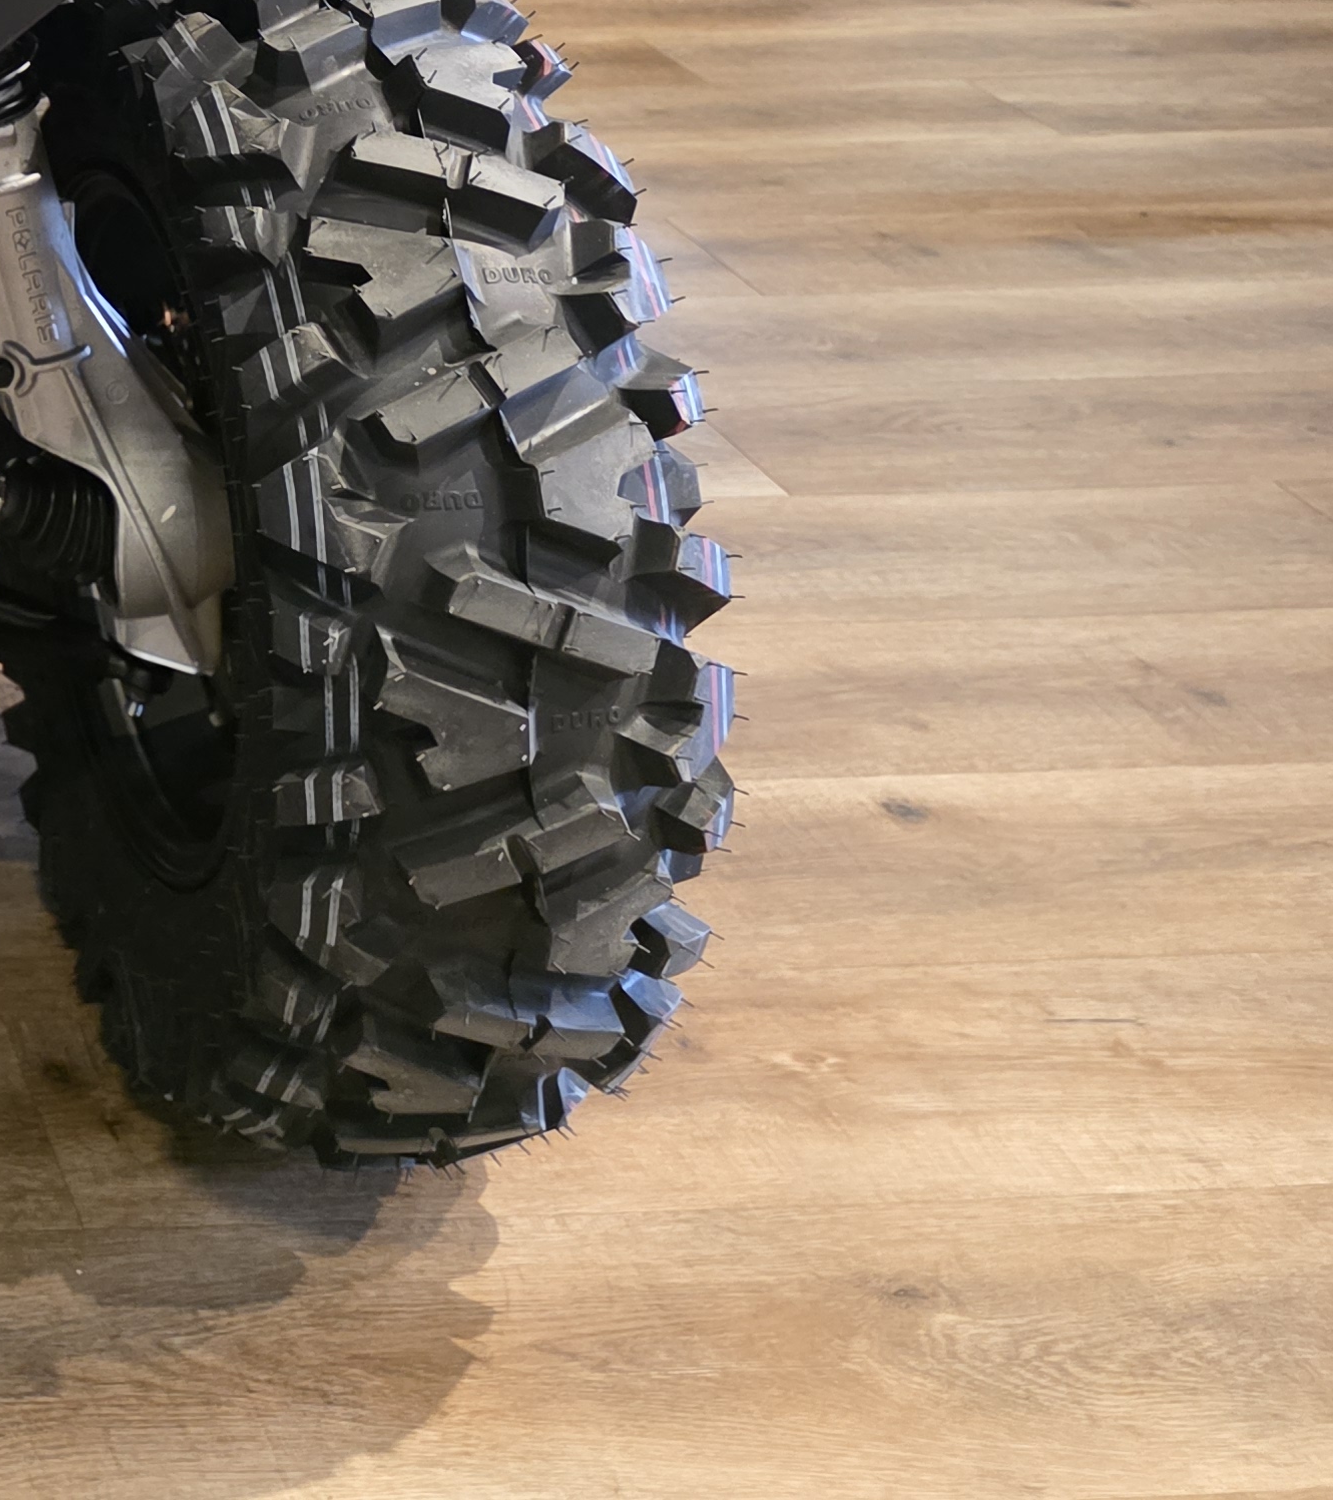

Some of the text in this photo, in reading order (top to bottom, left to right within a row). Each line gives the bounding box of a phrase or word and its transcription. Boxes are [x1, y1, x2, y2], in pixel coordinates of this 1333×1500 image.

[5, 206, 60, 345] POLARIS
[481, 266, 553, 286] DURO
[399, 489, 484, 512] DURO
